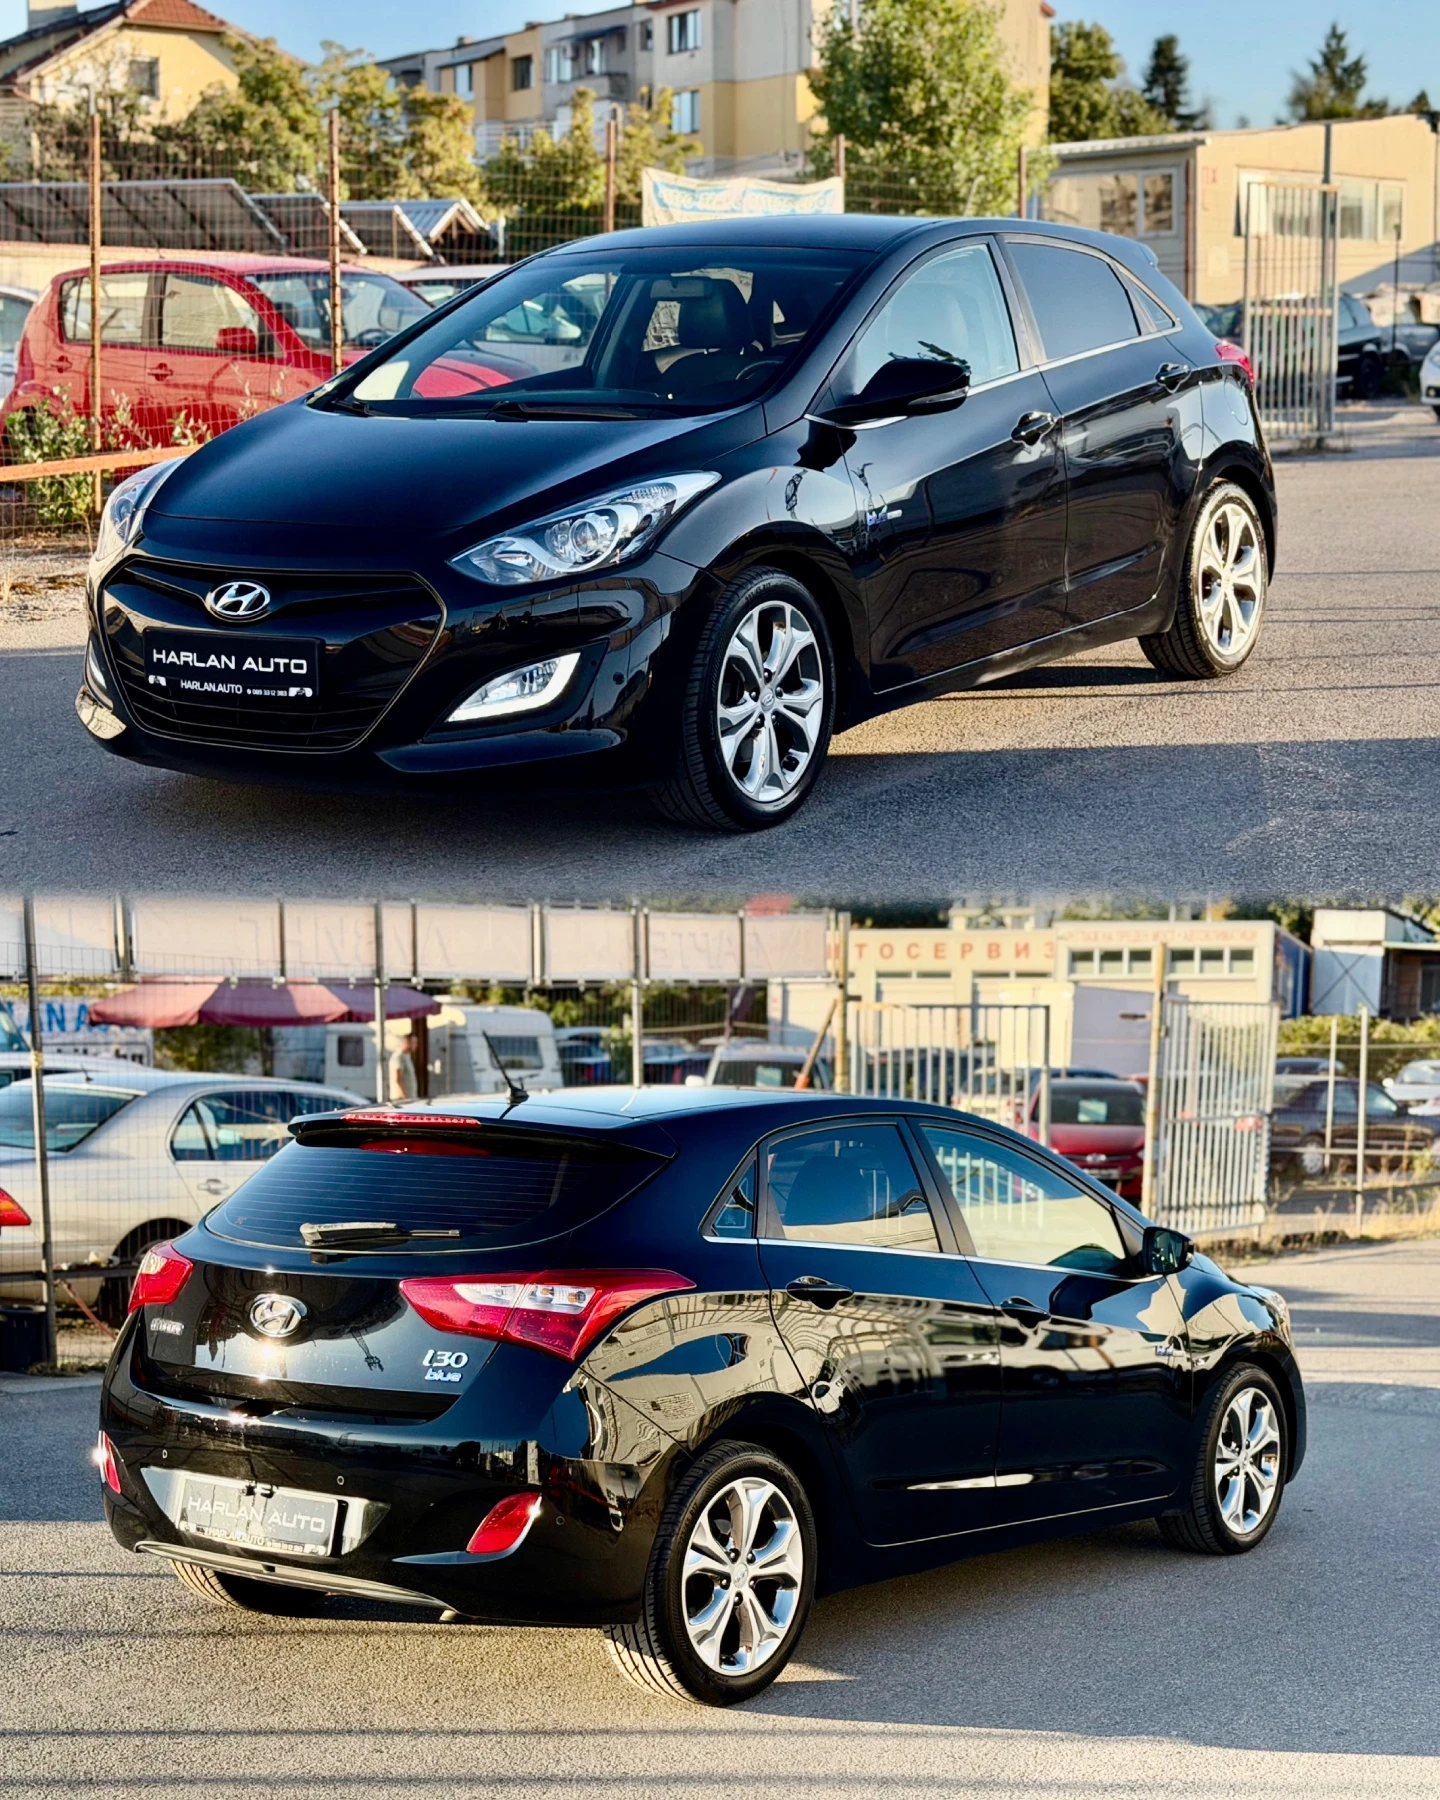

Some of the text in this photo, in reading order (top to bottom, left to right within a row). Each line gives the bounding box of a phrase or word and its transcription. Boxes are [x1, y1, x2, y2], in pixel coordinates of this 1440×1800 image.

[152, 648, 308, 675] HARLAN AUTO
[424, 1367, 462, 1383] blue
[187, 1496, 326, 1534] HARLAN AUTO
